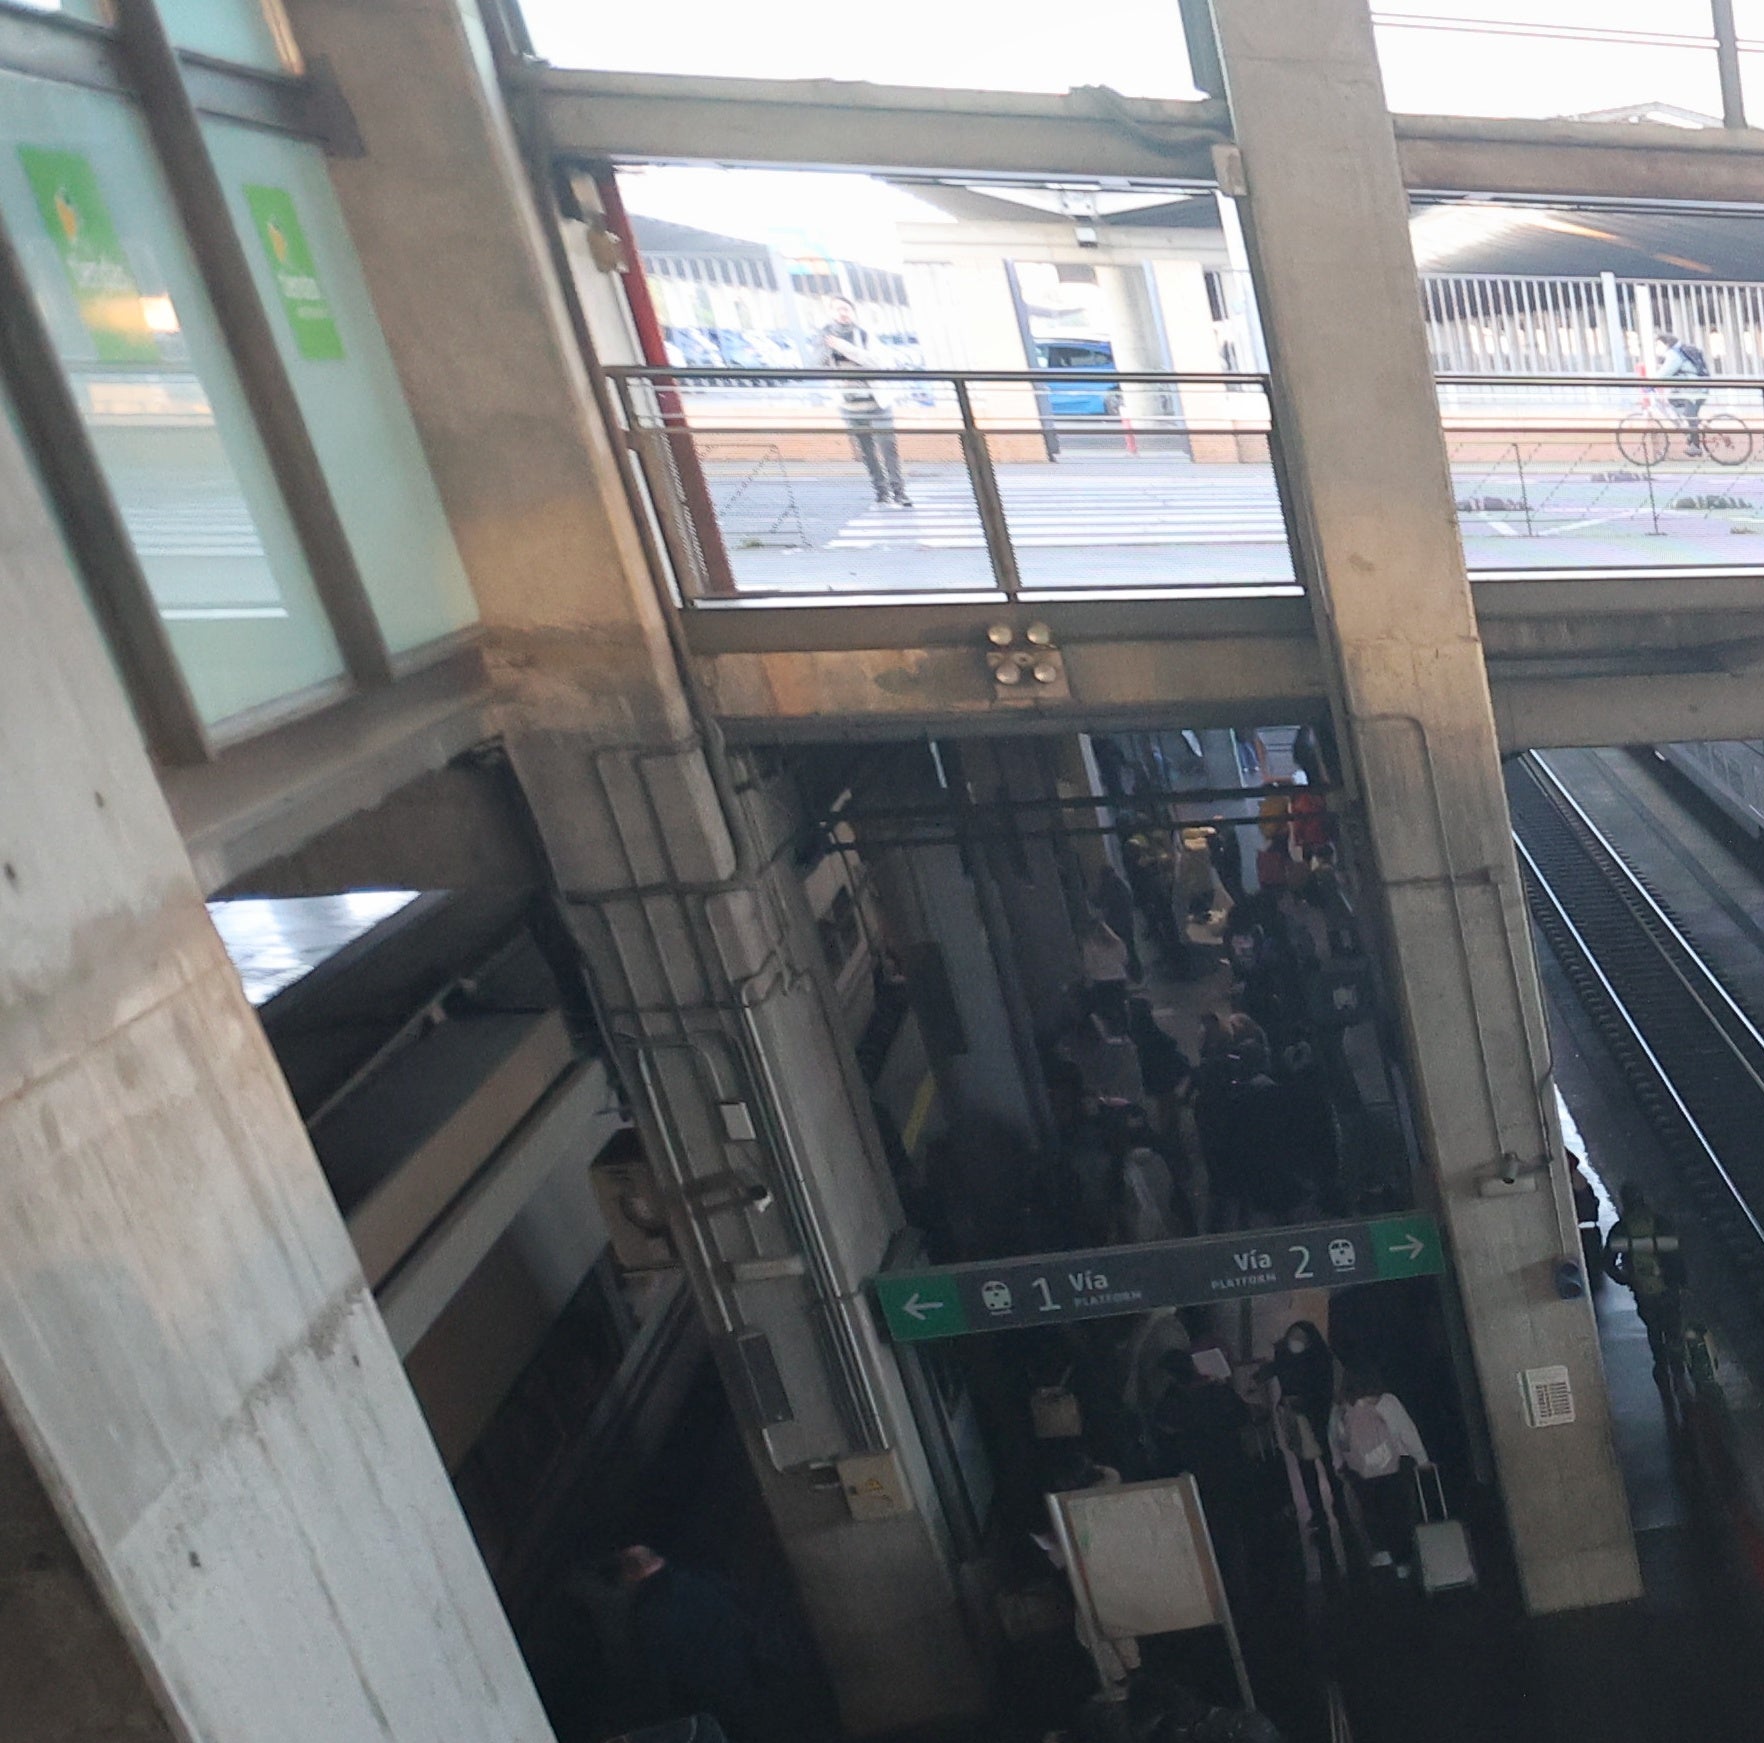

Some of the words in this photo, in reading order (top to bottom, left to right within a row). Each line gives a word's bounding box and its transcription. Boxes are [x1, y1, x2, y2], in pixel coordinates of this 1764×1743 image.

[1233, 1248, 1273, 1272] Vía
[1288, 1245, 1314, 1279] 2
[1031, 1276, 1062, 1312] 1
[1067, 1269, 1109, 1292] Vía
